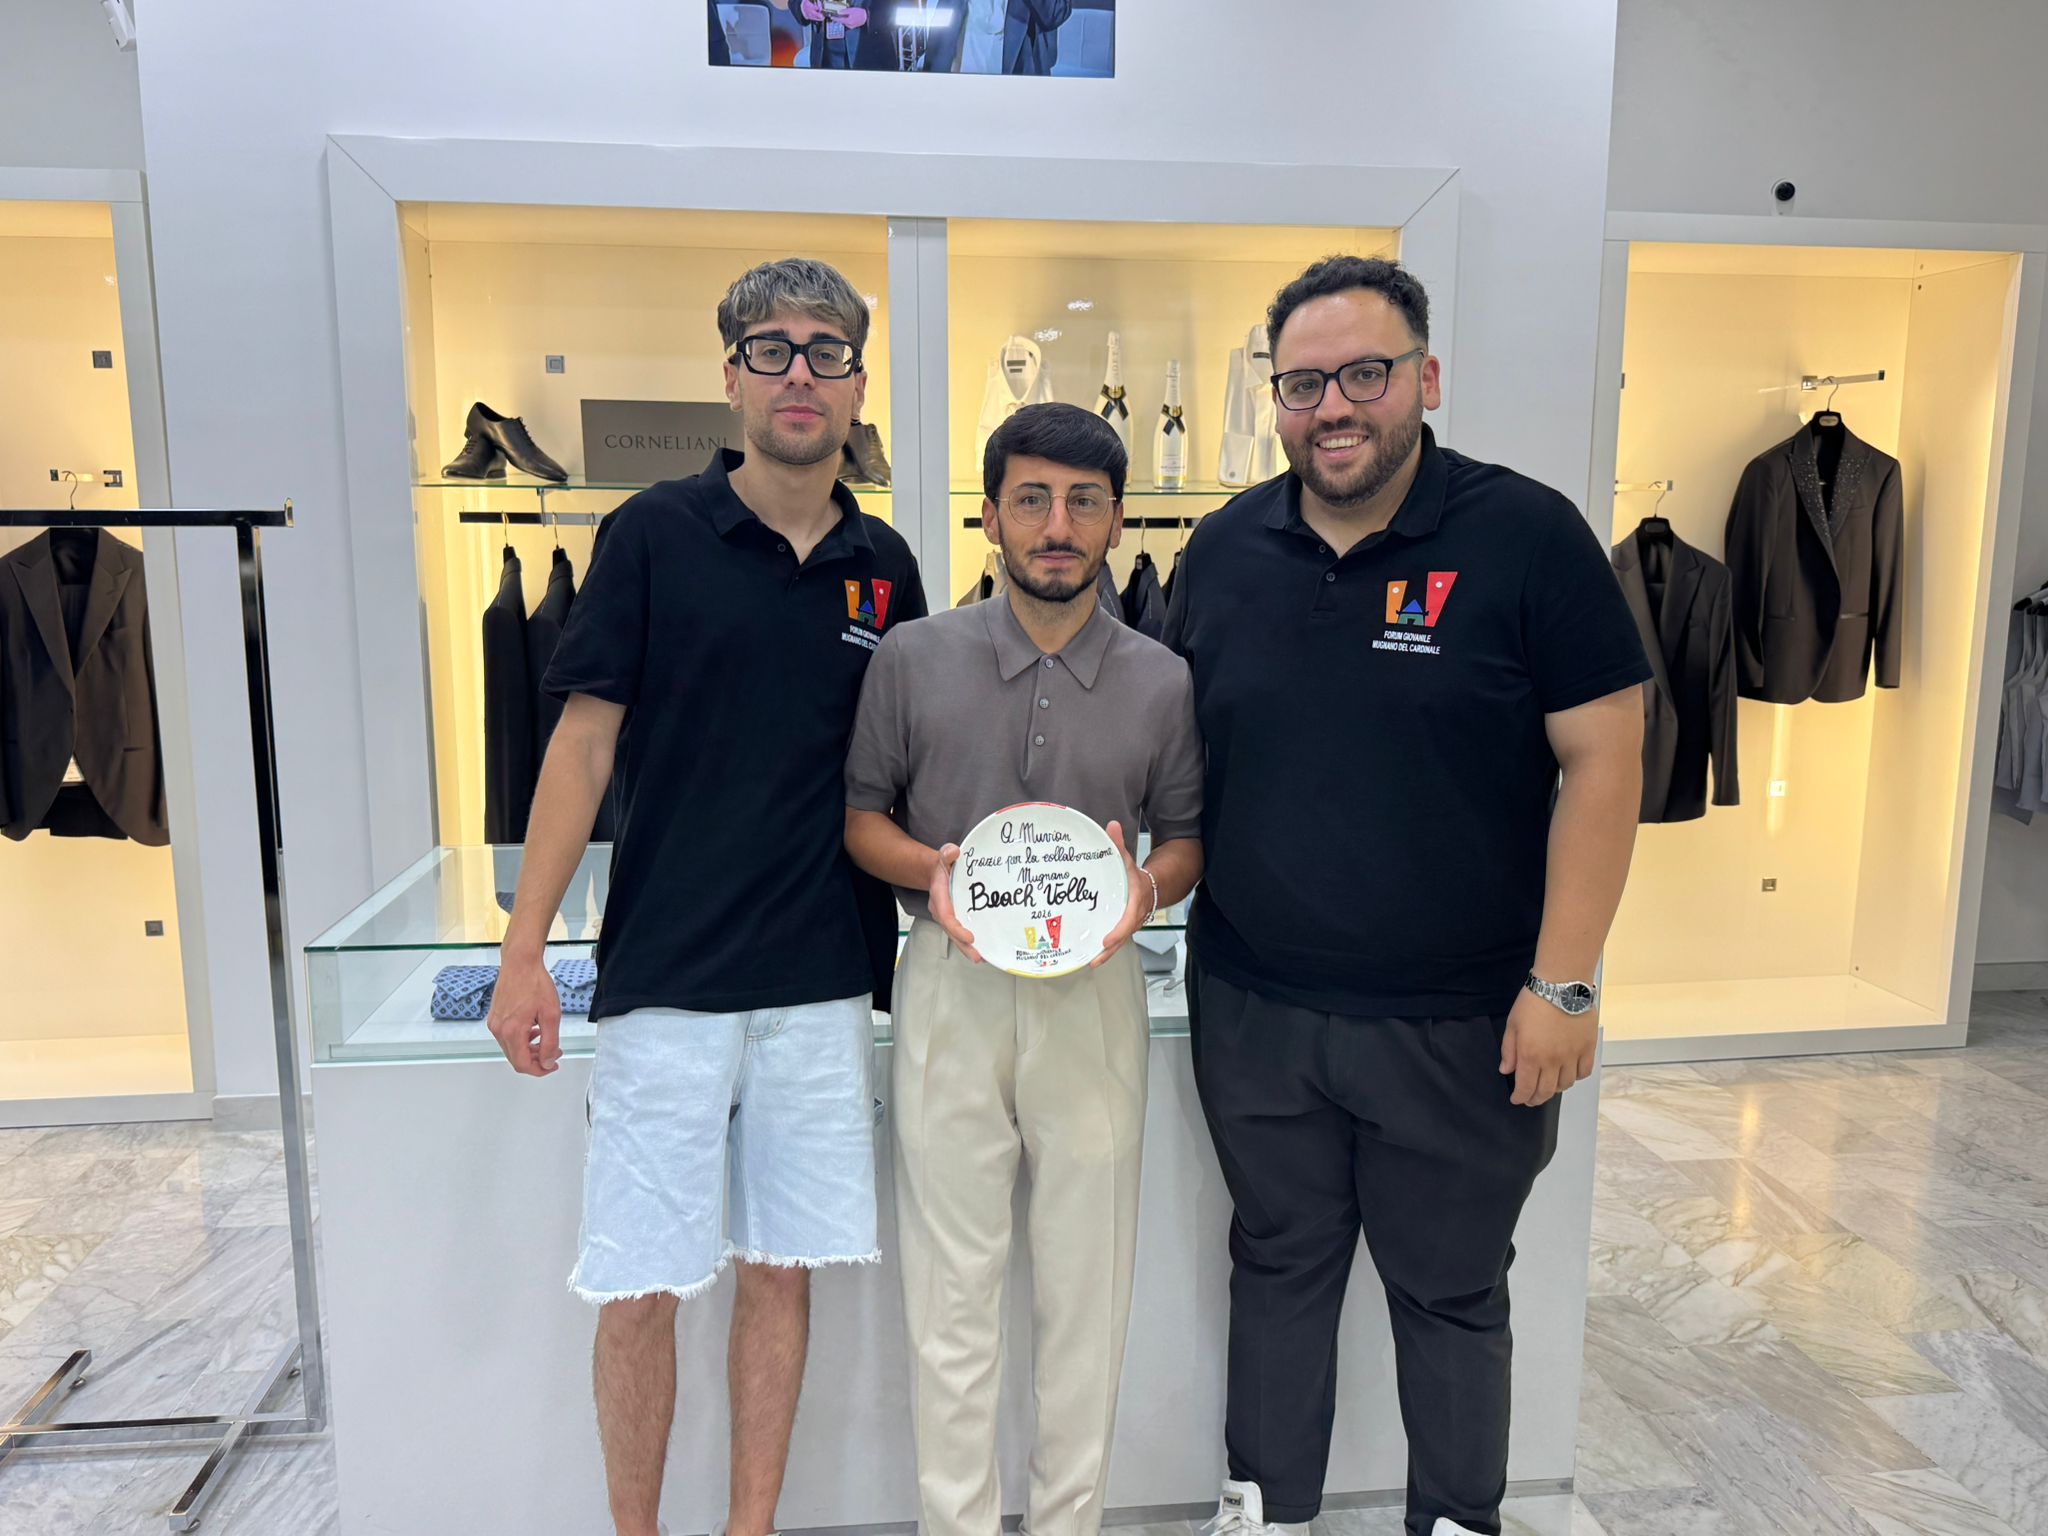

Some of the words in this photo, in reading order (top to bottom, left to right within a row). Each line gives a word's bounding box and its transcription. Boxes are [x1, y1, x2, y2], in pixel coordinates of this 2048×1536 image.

[604, 434, 728, 451] CORNELIANI
[1384, 630, 1403, 641] FORUM
[1402, 632, 1432, 643] GIOVANILE
[1372, 639, 1398, 652] MUGNANO
[1398, 643, 1409, 652] DEL
[1409, 644, 1441, 655] CARDINALE
[963, 846, 1003, 877] Grazie
[1005, 855, 1022, 873] per
[1025, 846, 1039, 864] la
[1042, 845, 1113, 863] collaborazione
[1017, 867, 1070, 890] Mugnano
[967, 882, 1036, 912] Beach
[1043, 876, 1099, 911] Volley
